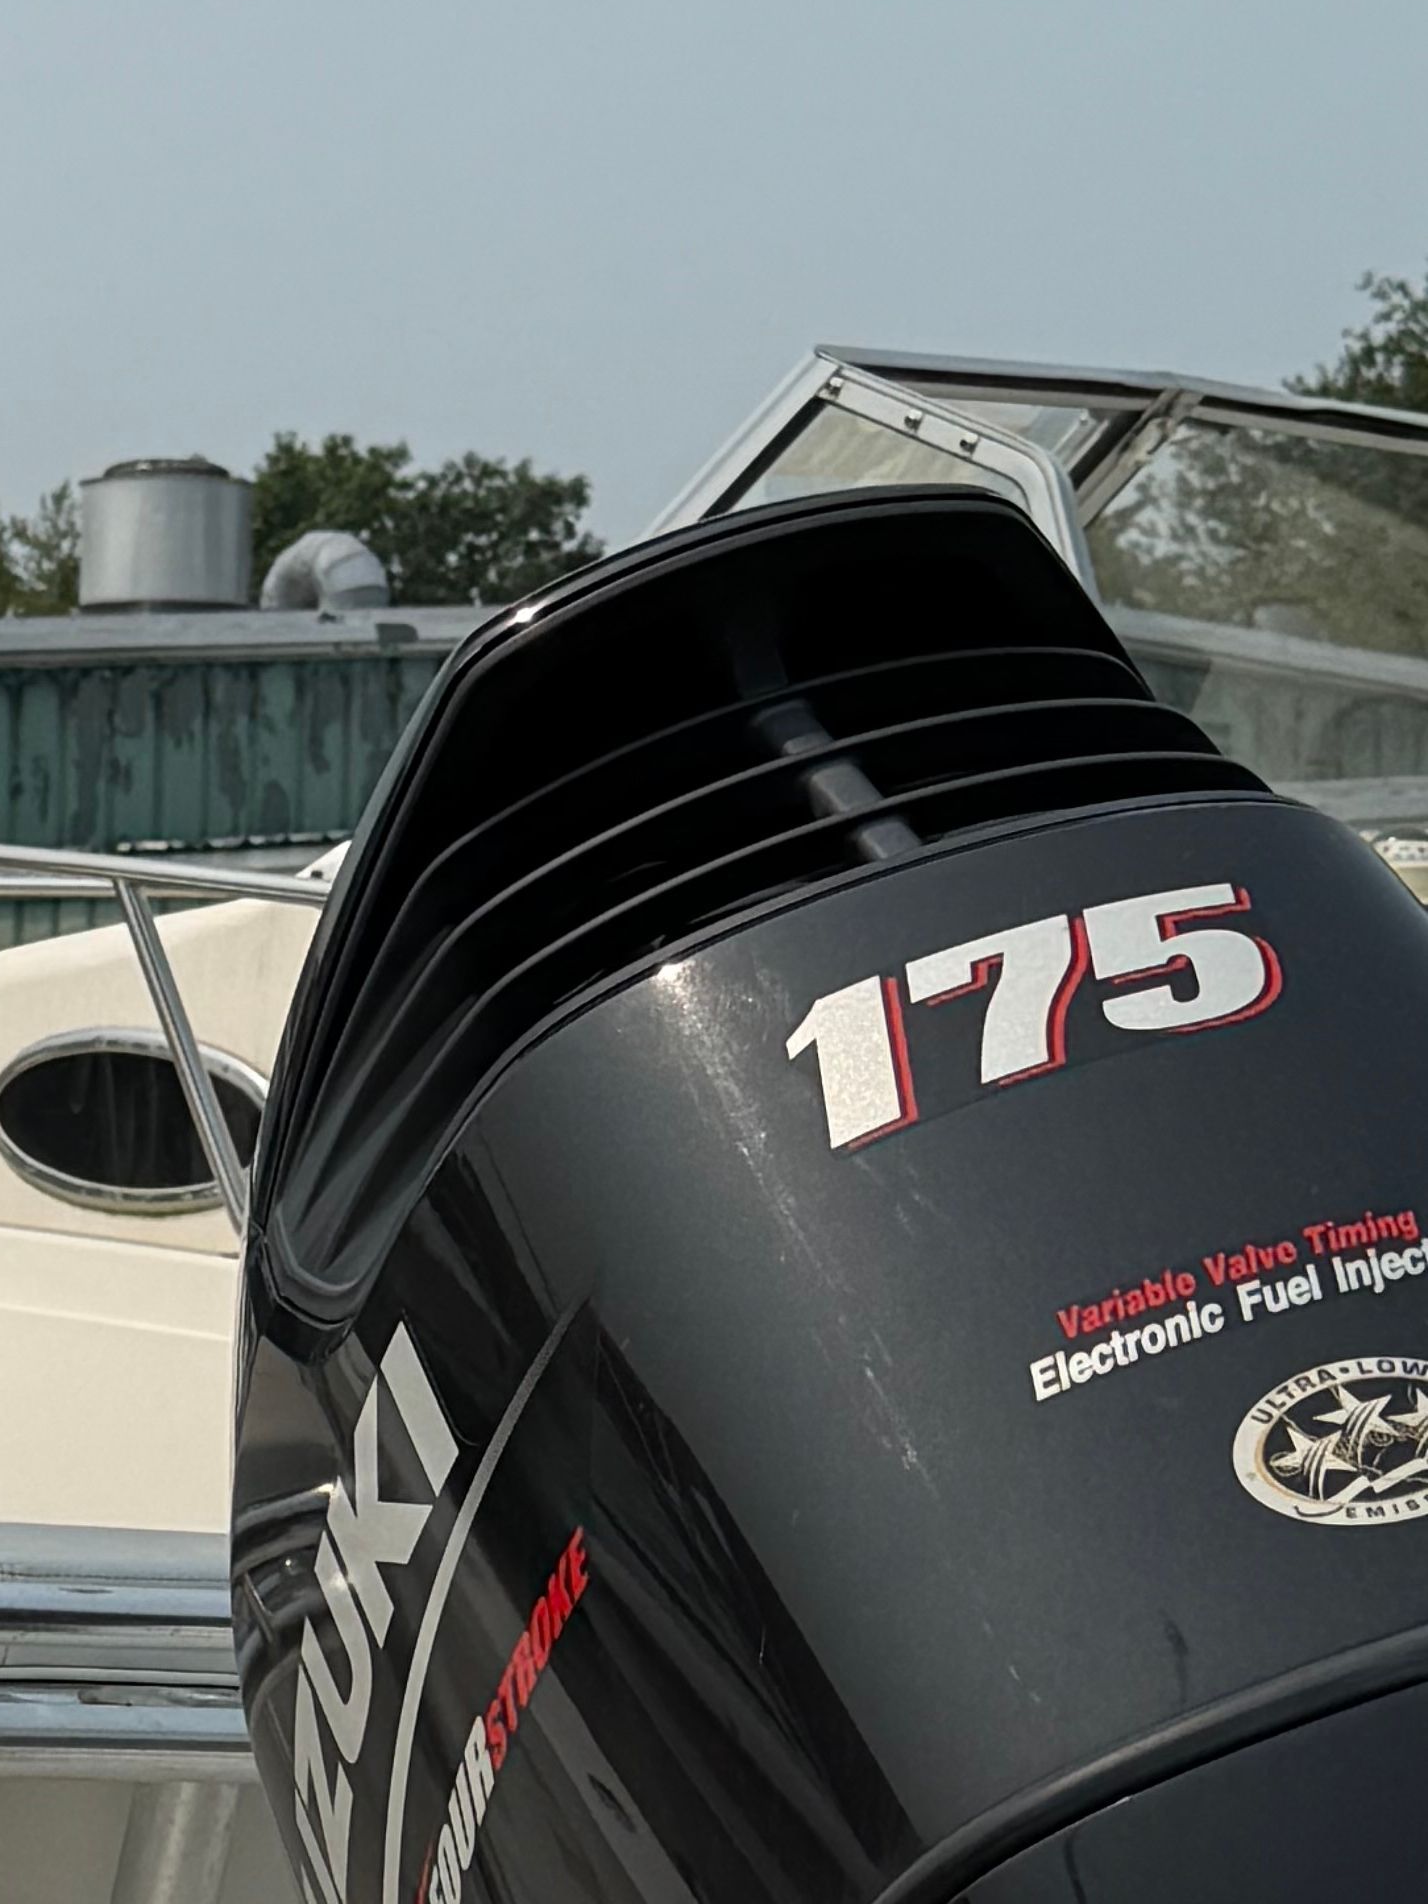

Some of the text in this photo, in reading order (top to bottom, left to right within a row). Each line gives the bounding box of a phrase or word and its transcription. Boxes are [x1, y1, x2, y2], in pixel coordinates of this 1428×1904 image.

[785, 882, 1282, 1151] 175
[1029, 1301, 1225, 1401] Electronic
[1236, 1264, 1322, 1322] Fuel
[1056, 1209, 1419, 1339] Variable Valve Timing
[1250, 1368, 1337, 1424] ULTRA
[1345, 1494, 1428, 1518] EMIS
